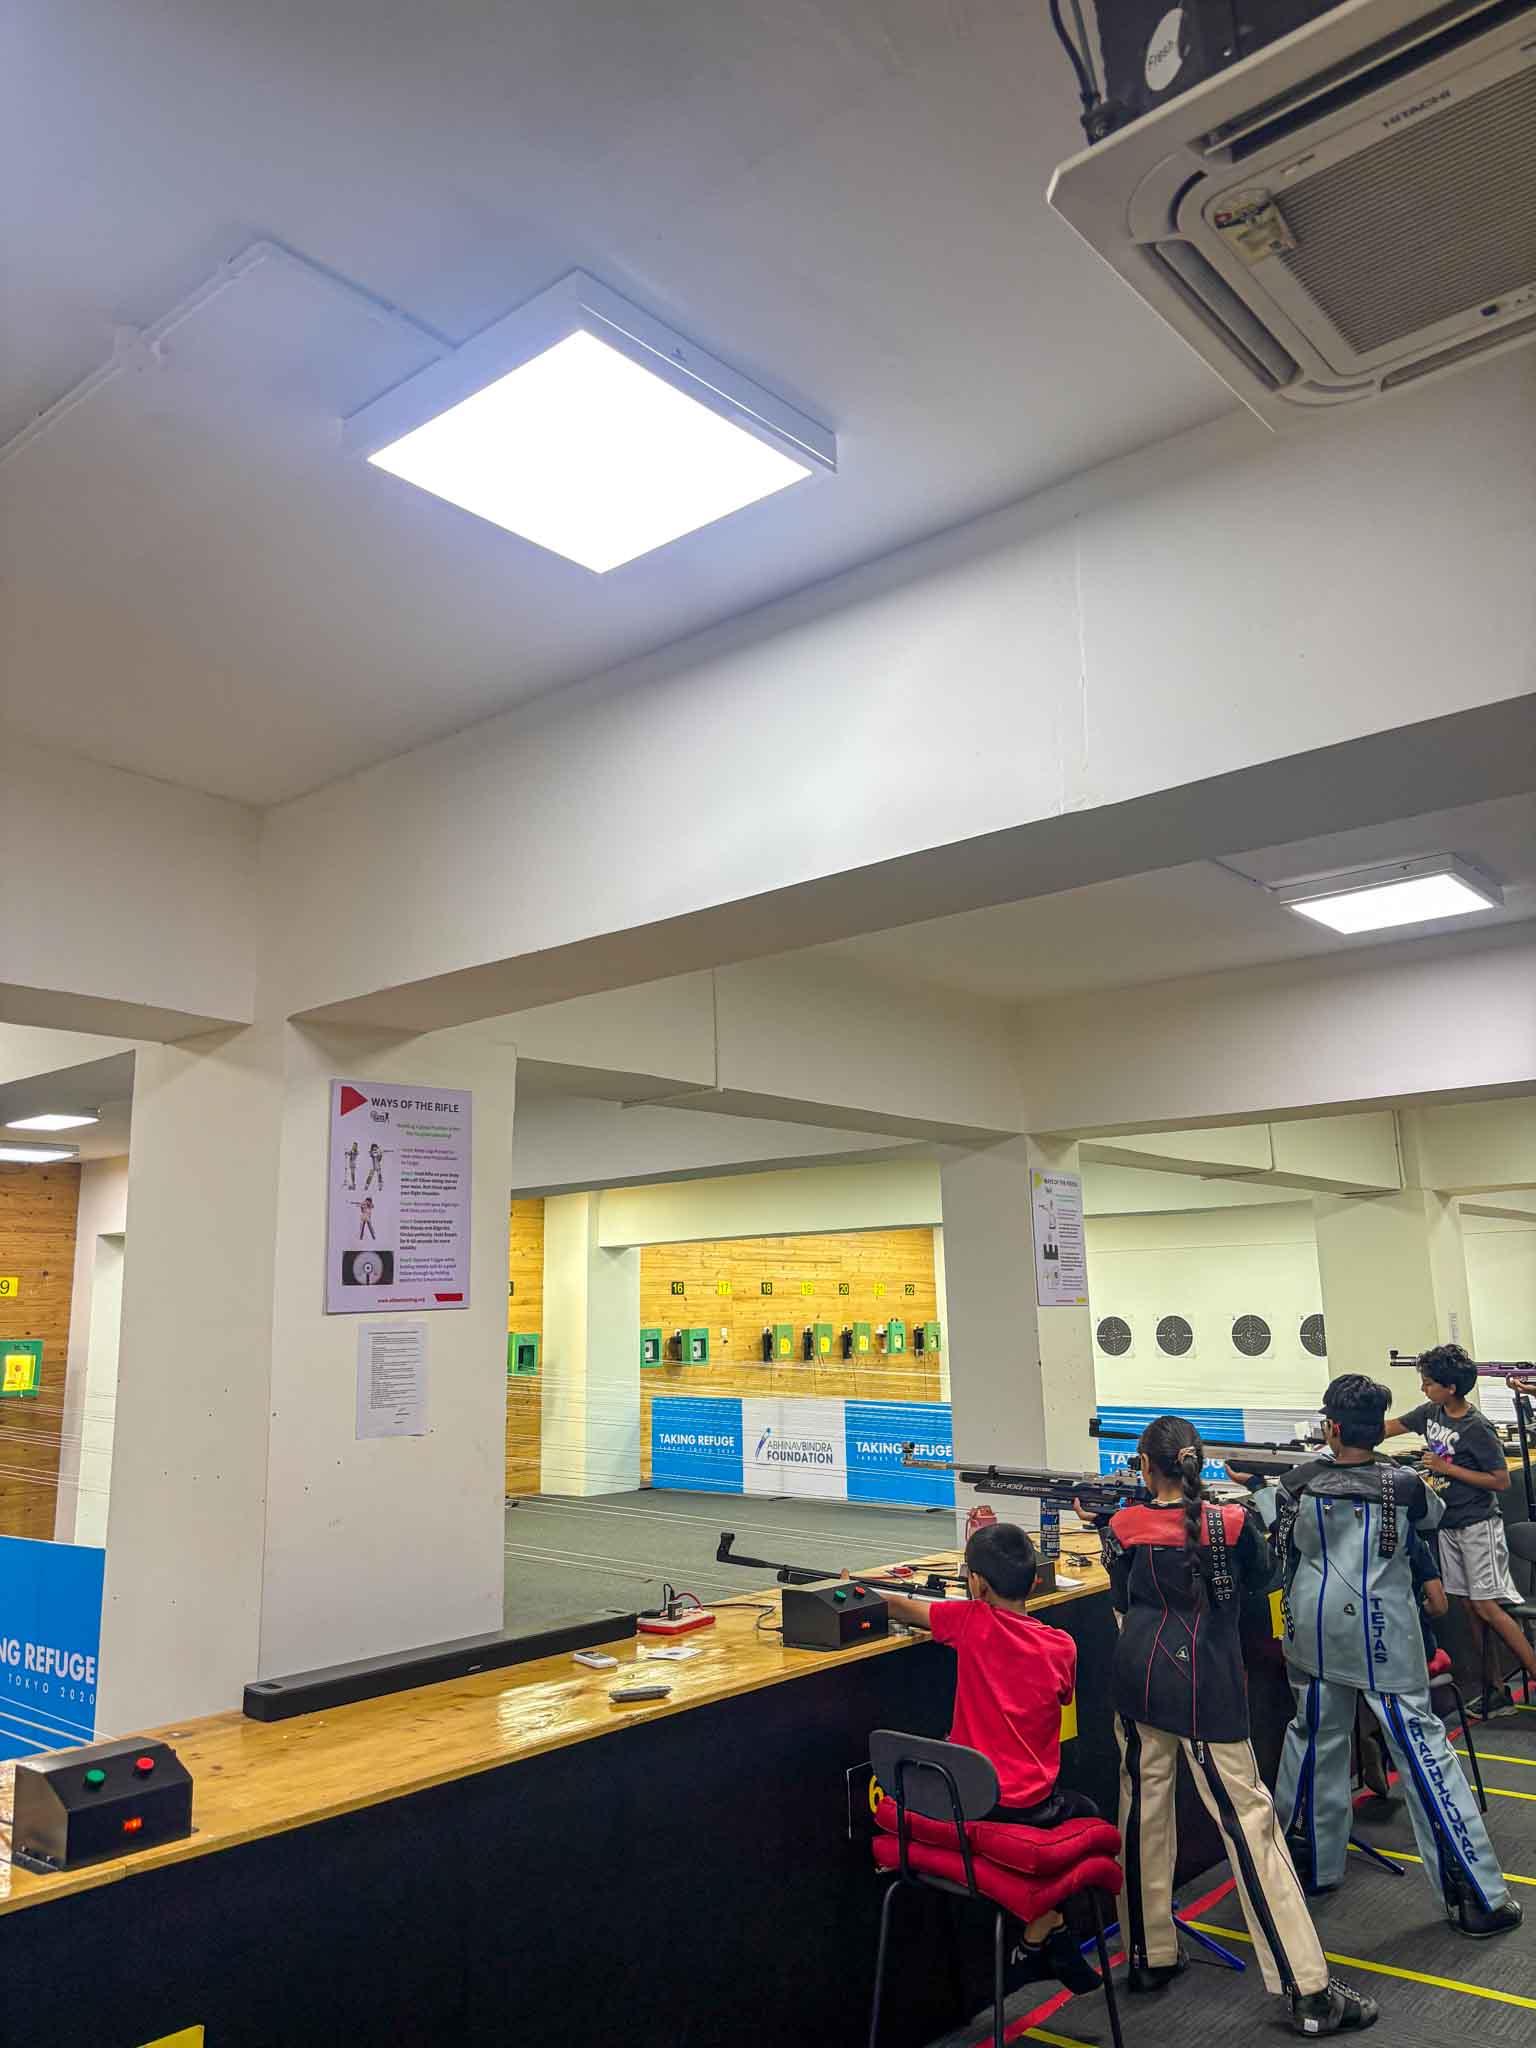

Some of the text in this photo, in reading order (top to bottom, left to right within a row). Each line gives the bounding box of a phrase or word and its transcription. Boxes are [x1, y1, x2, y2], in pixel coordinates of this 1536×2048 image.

[371, 1097, 459, 1112] WAYS OF THE RIFLE
[659, 1433, 735, 1447] TAKING REFUGE
[768, 1450, 833, 1464] FOUNDATION
[856, 1441, 953, 1457] TAKING EFUGE
[1370, 1597, 1389, 1664] TEJAS
[25, 1642, 96, 1685] REFUGE
[8, 1672, 95, 1705] TOKYO 2020
